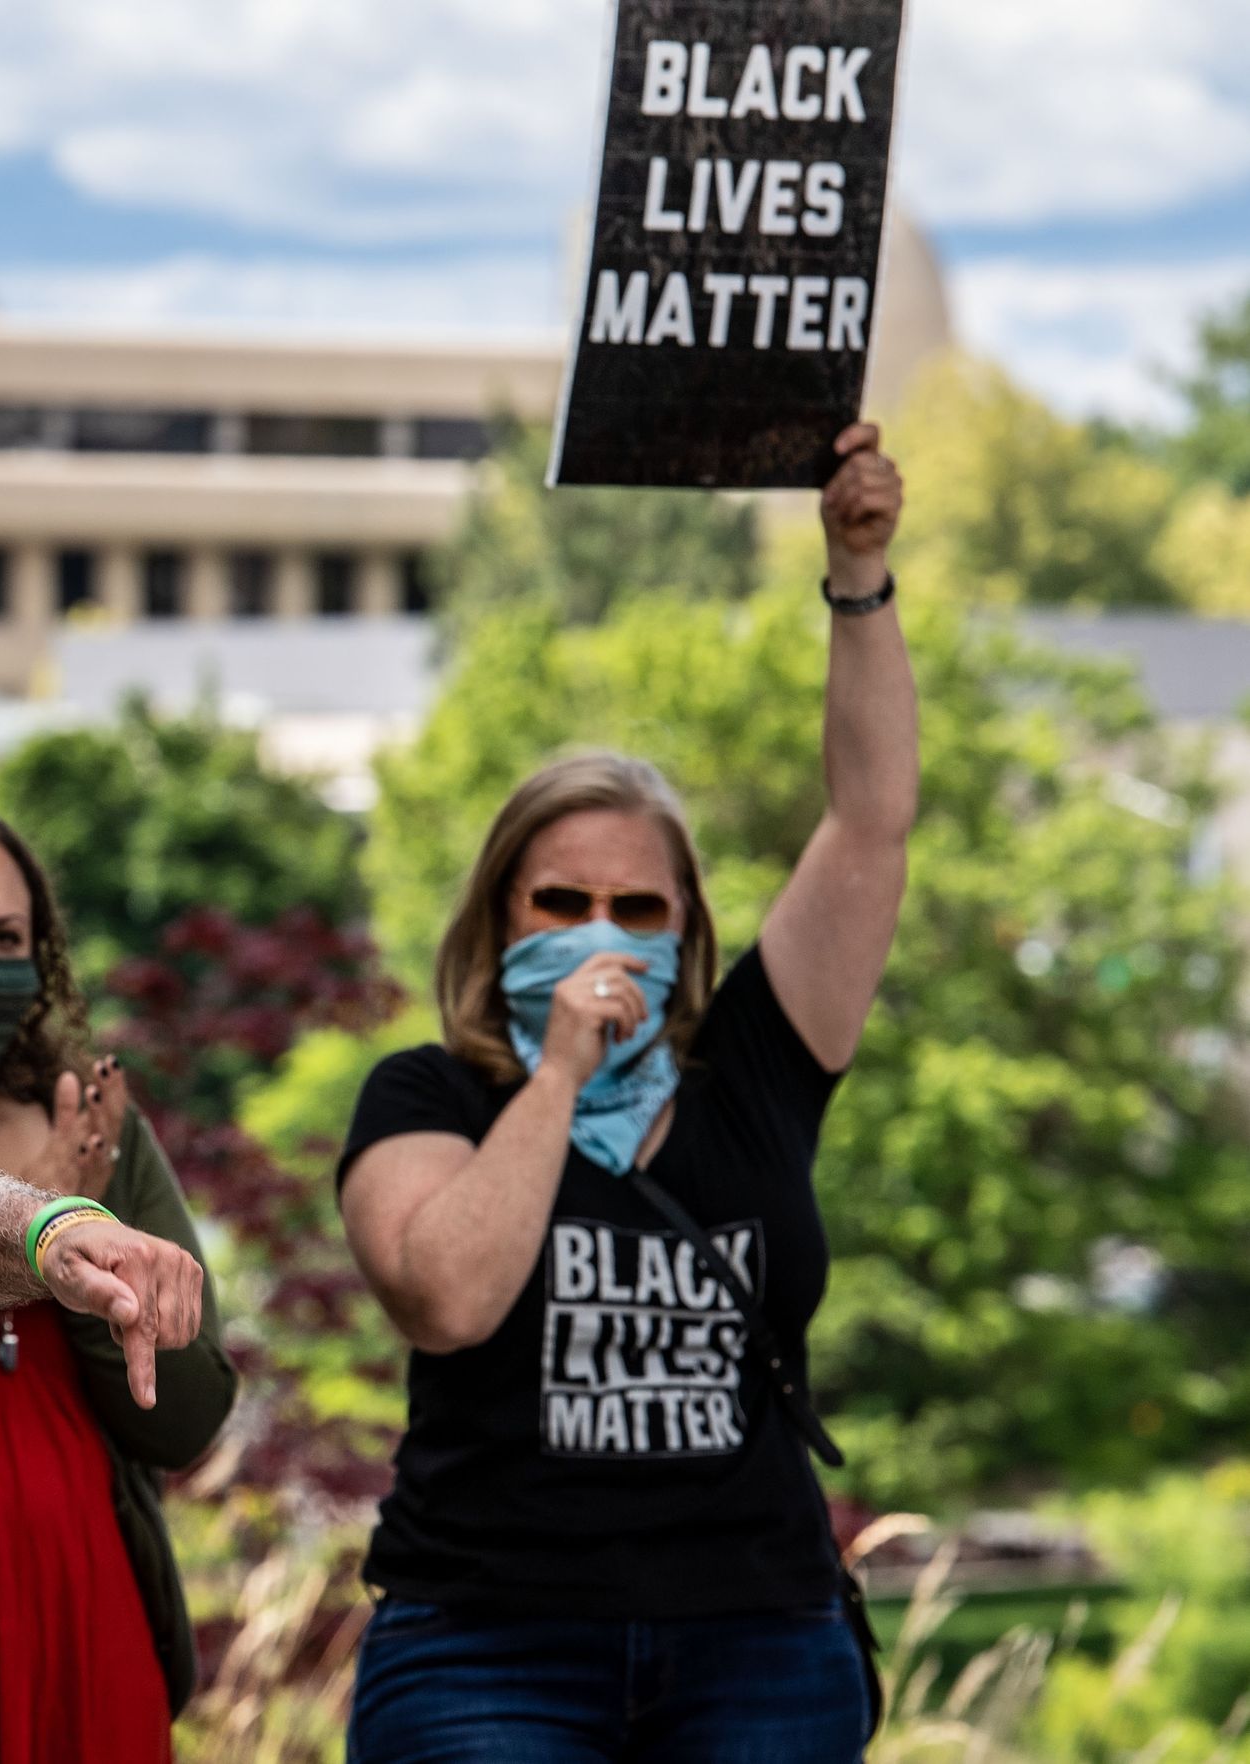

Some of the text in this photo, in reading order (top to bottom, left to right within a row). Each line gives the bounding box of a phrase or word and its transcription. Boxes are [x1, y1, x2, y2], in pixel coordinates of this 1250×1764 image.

[641, 40, 872, 123] BLACK
[642, 156, 846, 237] LIVES
[588, 269, 870, 351] MATTER
[553, 1224, 754, 1310] BLACK
[550, 1311, 745, 1387] LIVES
[548, 1390, 744, 1452] MATTER
